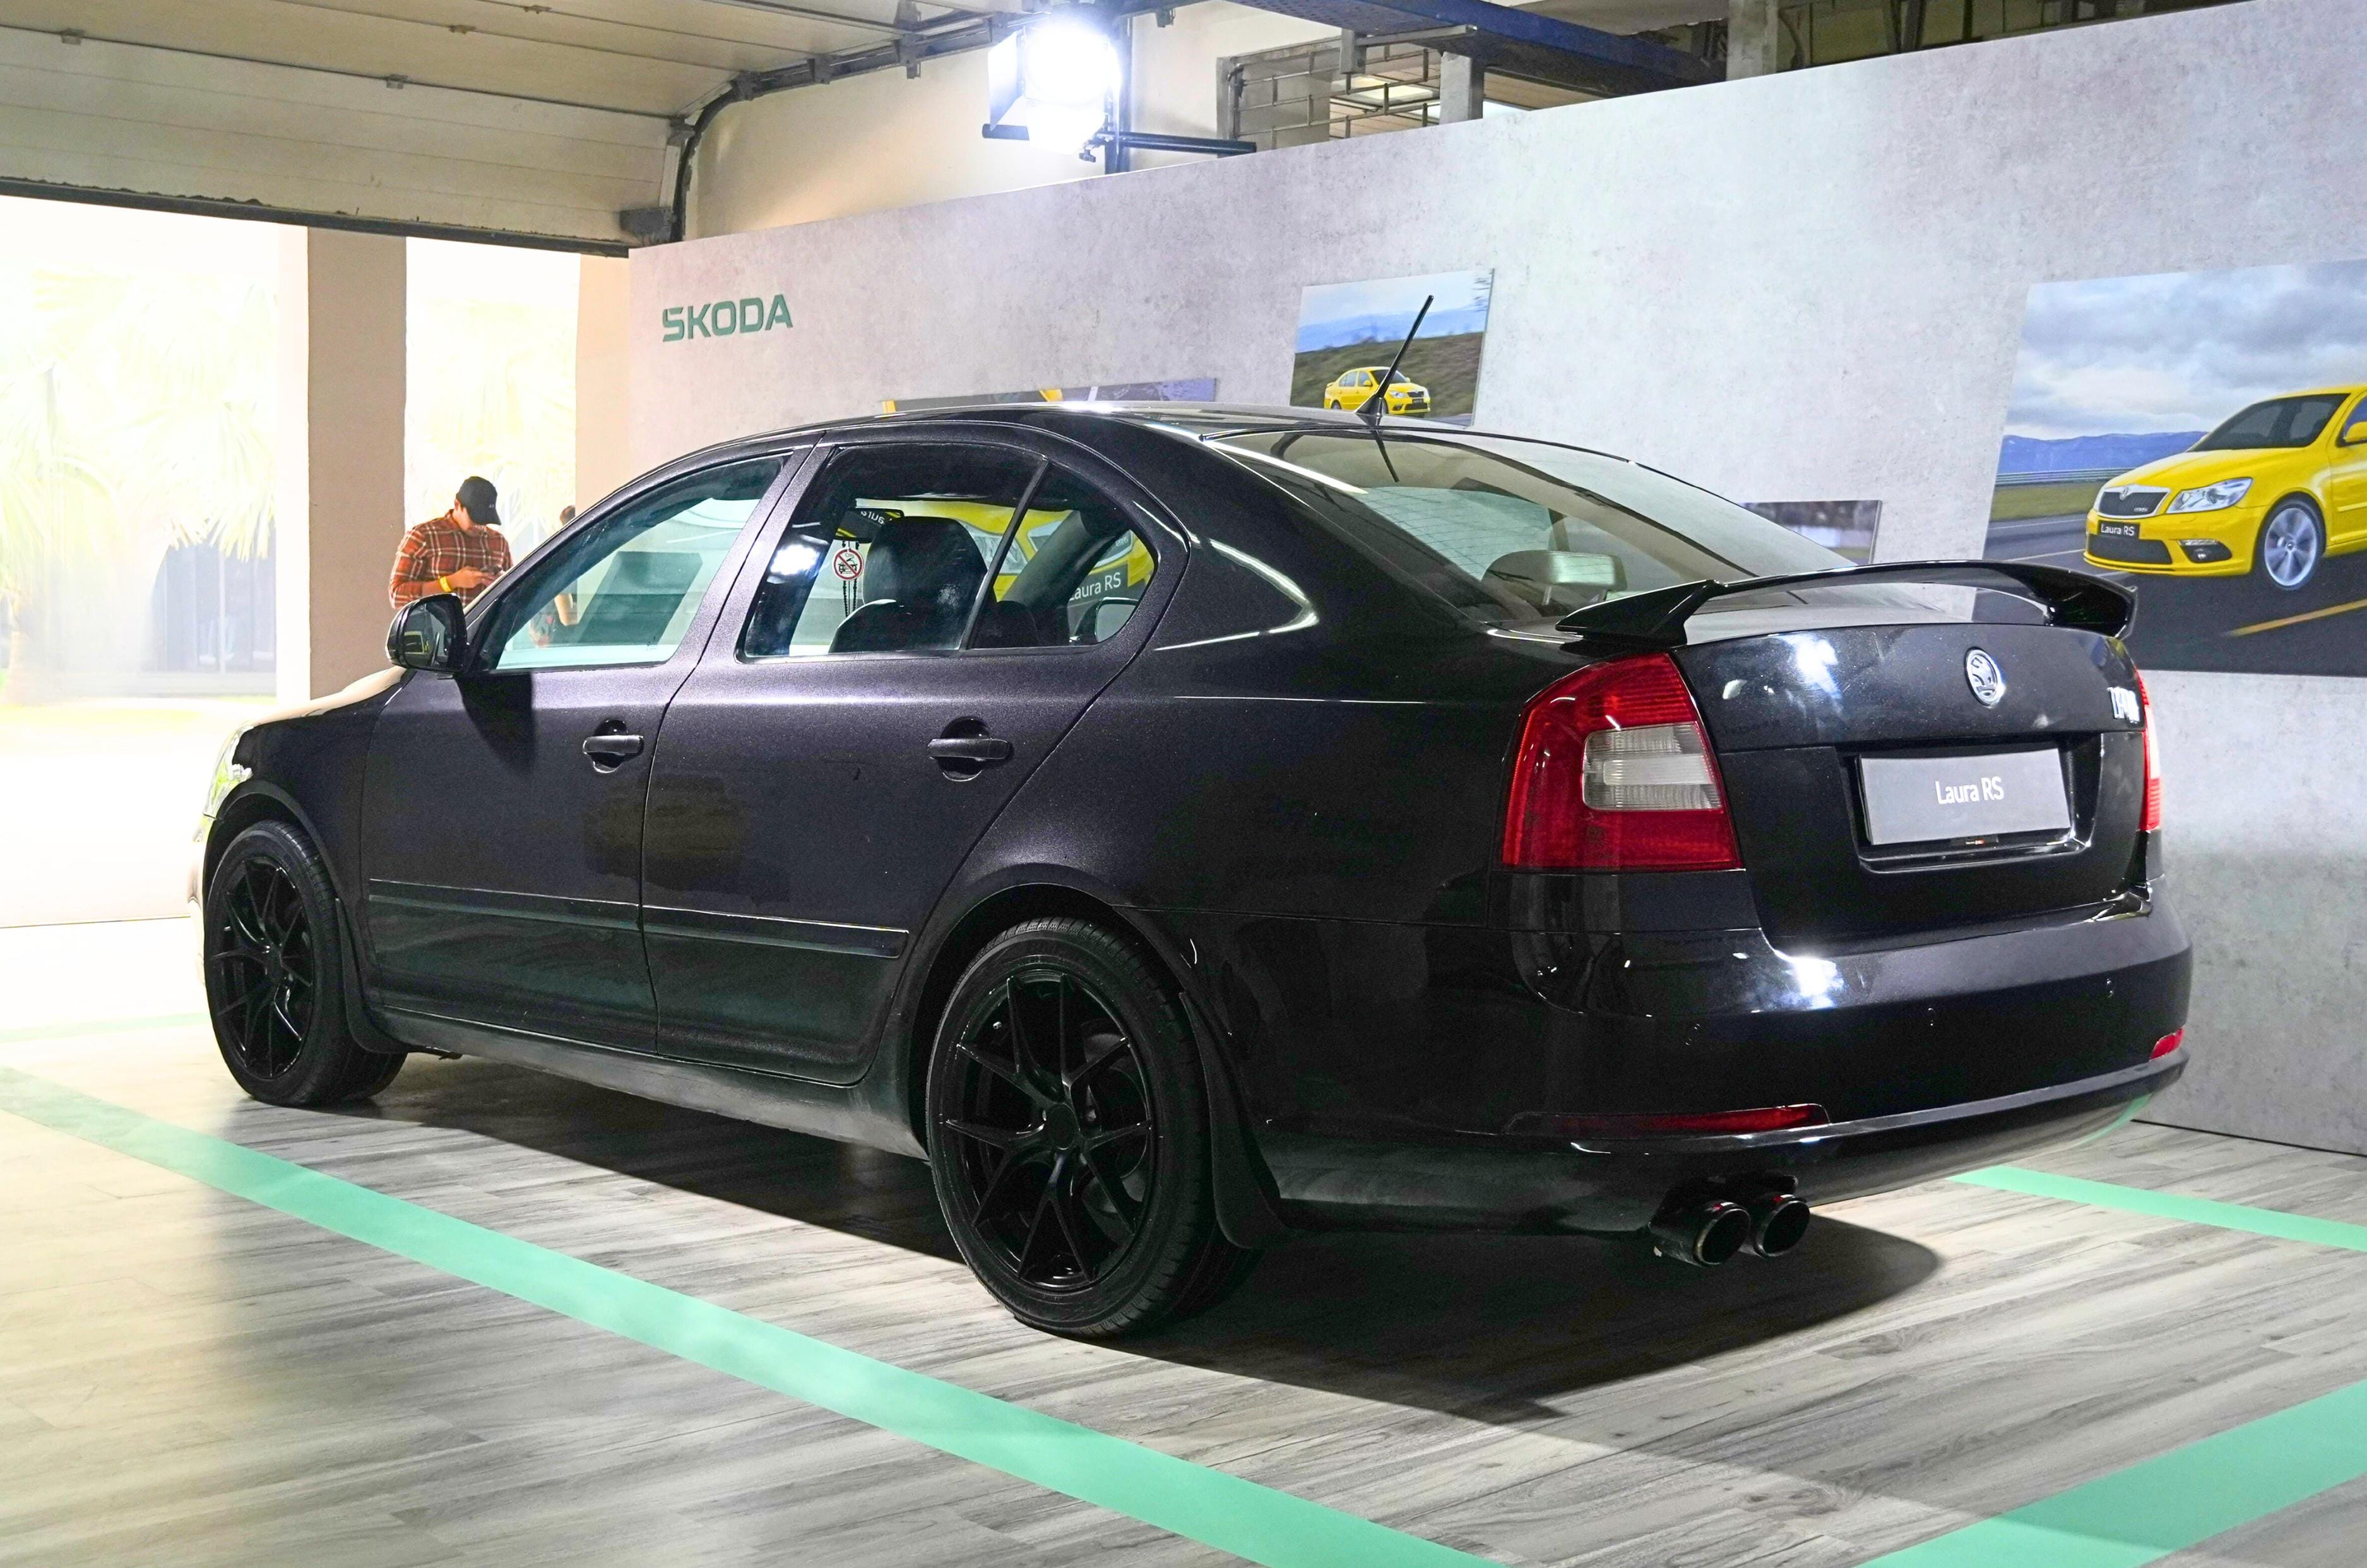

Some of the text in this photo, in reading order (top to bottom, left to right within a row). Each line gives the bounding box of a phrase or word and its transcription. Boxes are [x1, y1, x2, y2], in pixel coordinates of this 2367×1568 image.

[2101, 523, 2135, 537] Laura RS
[1069, 572, 1122, 602] aura RS
[1935, 776, 2005, 804] Laura RS
